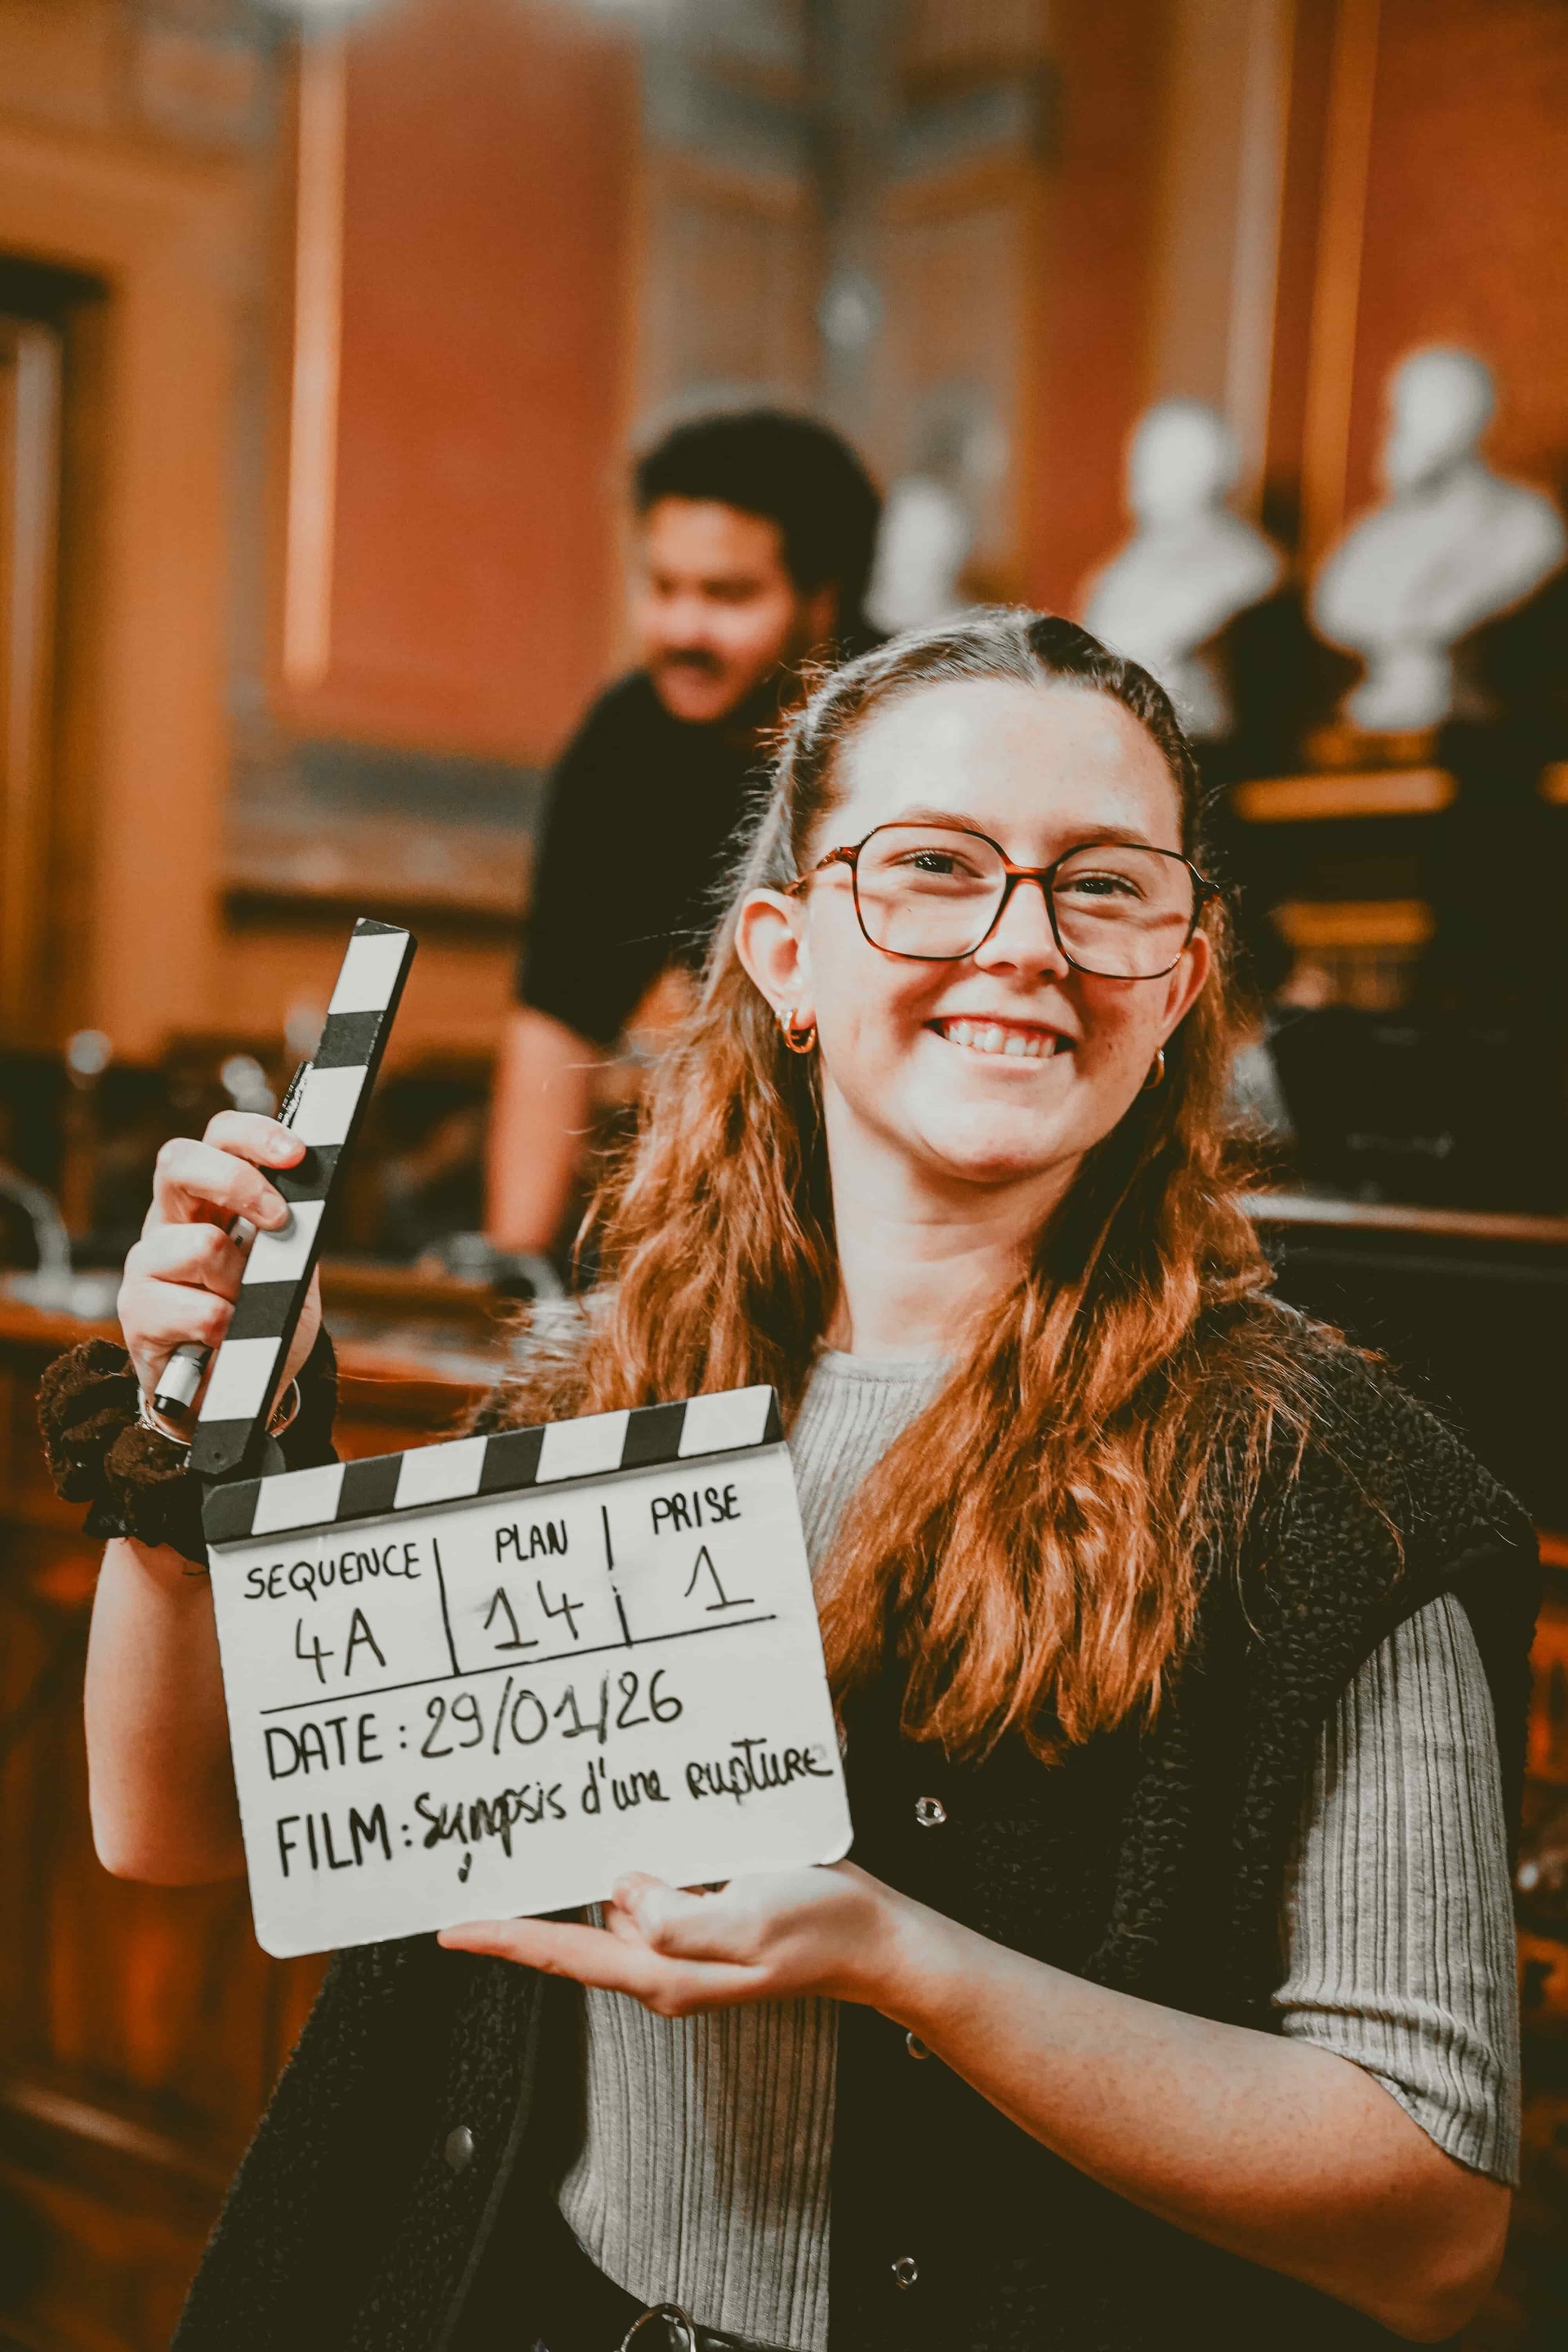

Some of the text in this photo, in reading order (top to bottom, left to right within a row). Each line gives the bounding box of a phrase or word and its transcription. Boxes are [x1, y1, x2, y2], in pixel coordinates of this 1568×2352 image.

[496, 1520, 568, 1562] PLAN
[651, 1484, 741, 1535] PRISE
[244, 1543, 421, 1601] SEQUENCE
[684, 1545, 755, 1611] 1
[296, 1607, 387, 1684] 4A
[483, 1579, 584, 1650] 14
[421, 1668, 683, 1758] 29/01/26
